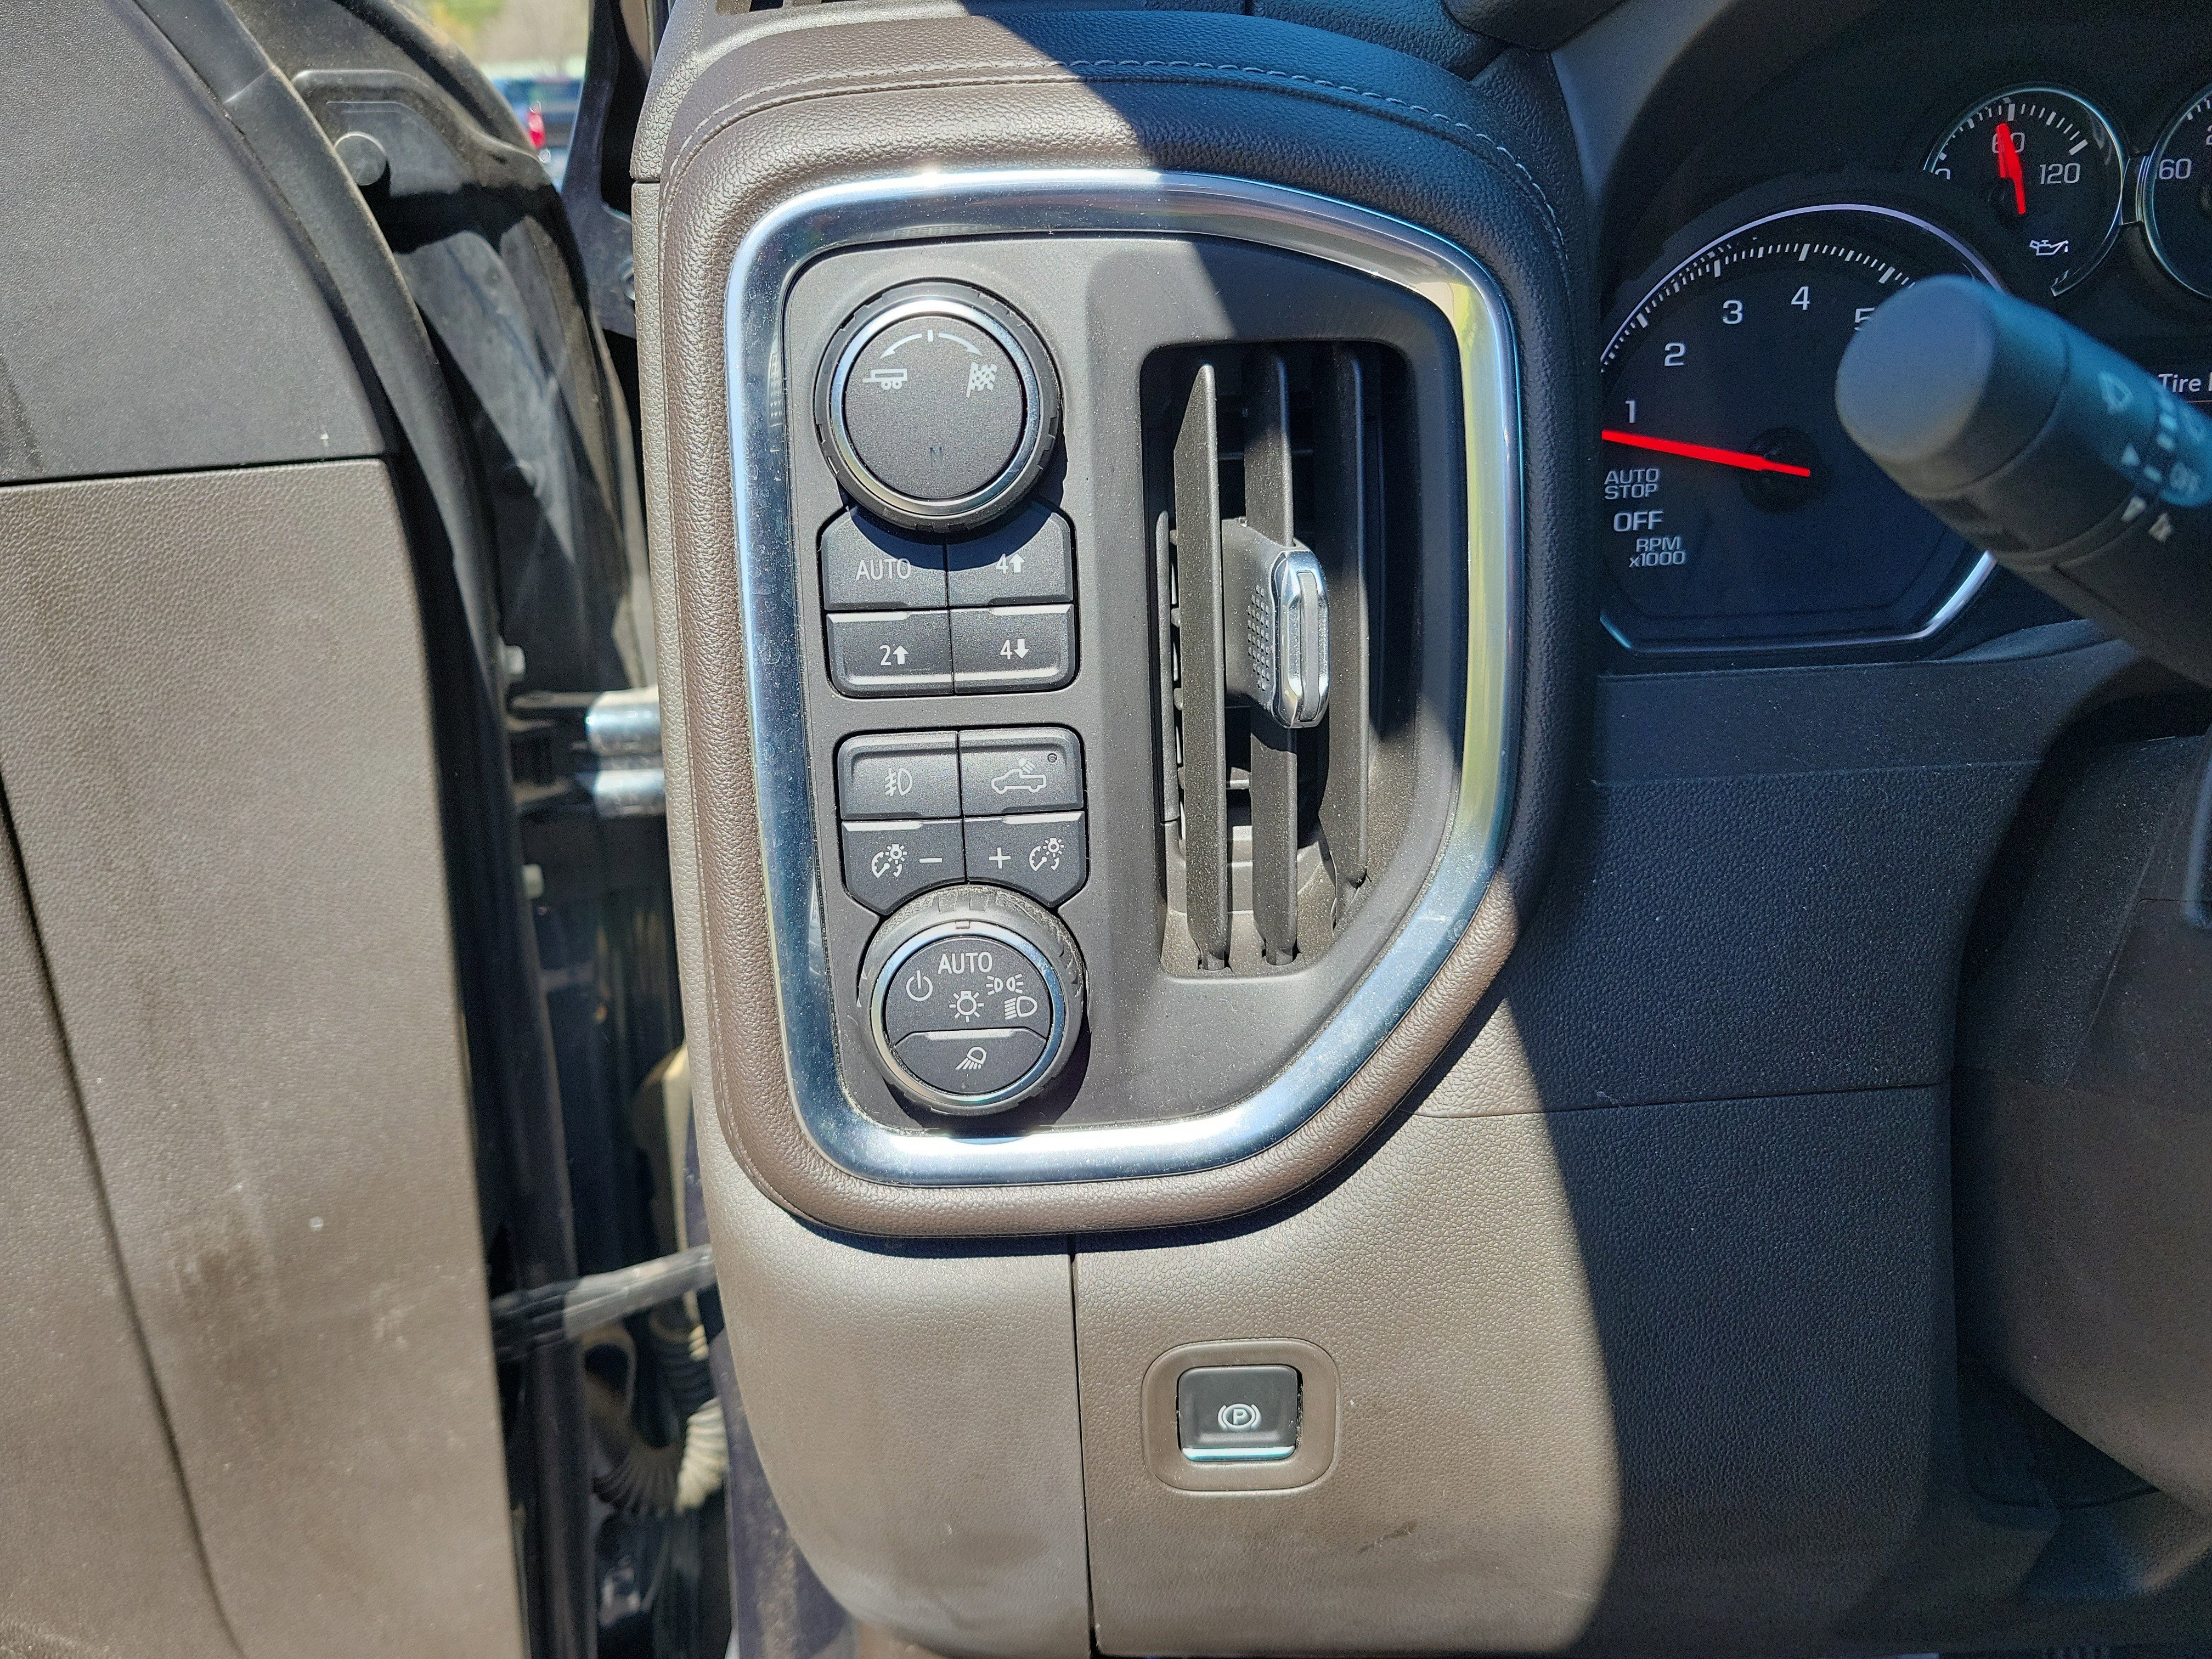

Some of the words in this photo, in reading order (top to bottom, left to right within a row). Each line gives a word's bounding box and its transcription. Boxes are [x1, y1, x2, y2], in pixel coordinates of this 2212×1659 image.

[2039, 163, 2080, 184] 120
[2159, 158, 2192, 180] 60
[1791, 285, 1810, 311] 4
[1722, 300, 1743, 325] 3
[1664, 342, 1686, 366] 2
[2158, 373, 2201, 393] Tire
[1624, 399, 1636, 424] 1
[1604, 468, 1660, 485] AUTO
[1604, 483, 1658, 500] STOP
[1613, 510, 1664, 532] OFF
[1636, 536, 1681, 552] RPM
[856, 557, 911, 580] AUTO
[996, 554, 1008, 574] 4
[1628, 550, 1686, 568] x1000
[879, 645, 892, 665] 2
[1000, 639, 1013, 659] 4
[938, 951, 993, 974] AUTO
